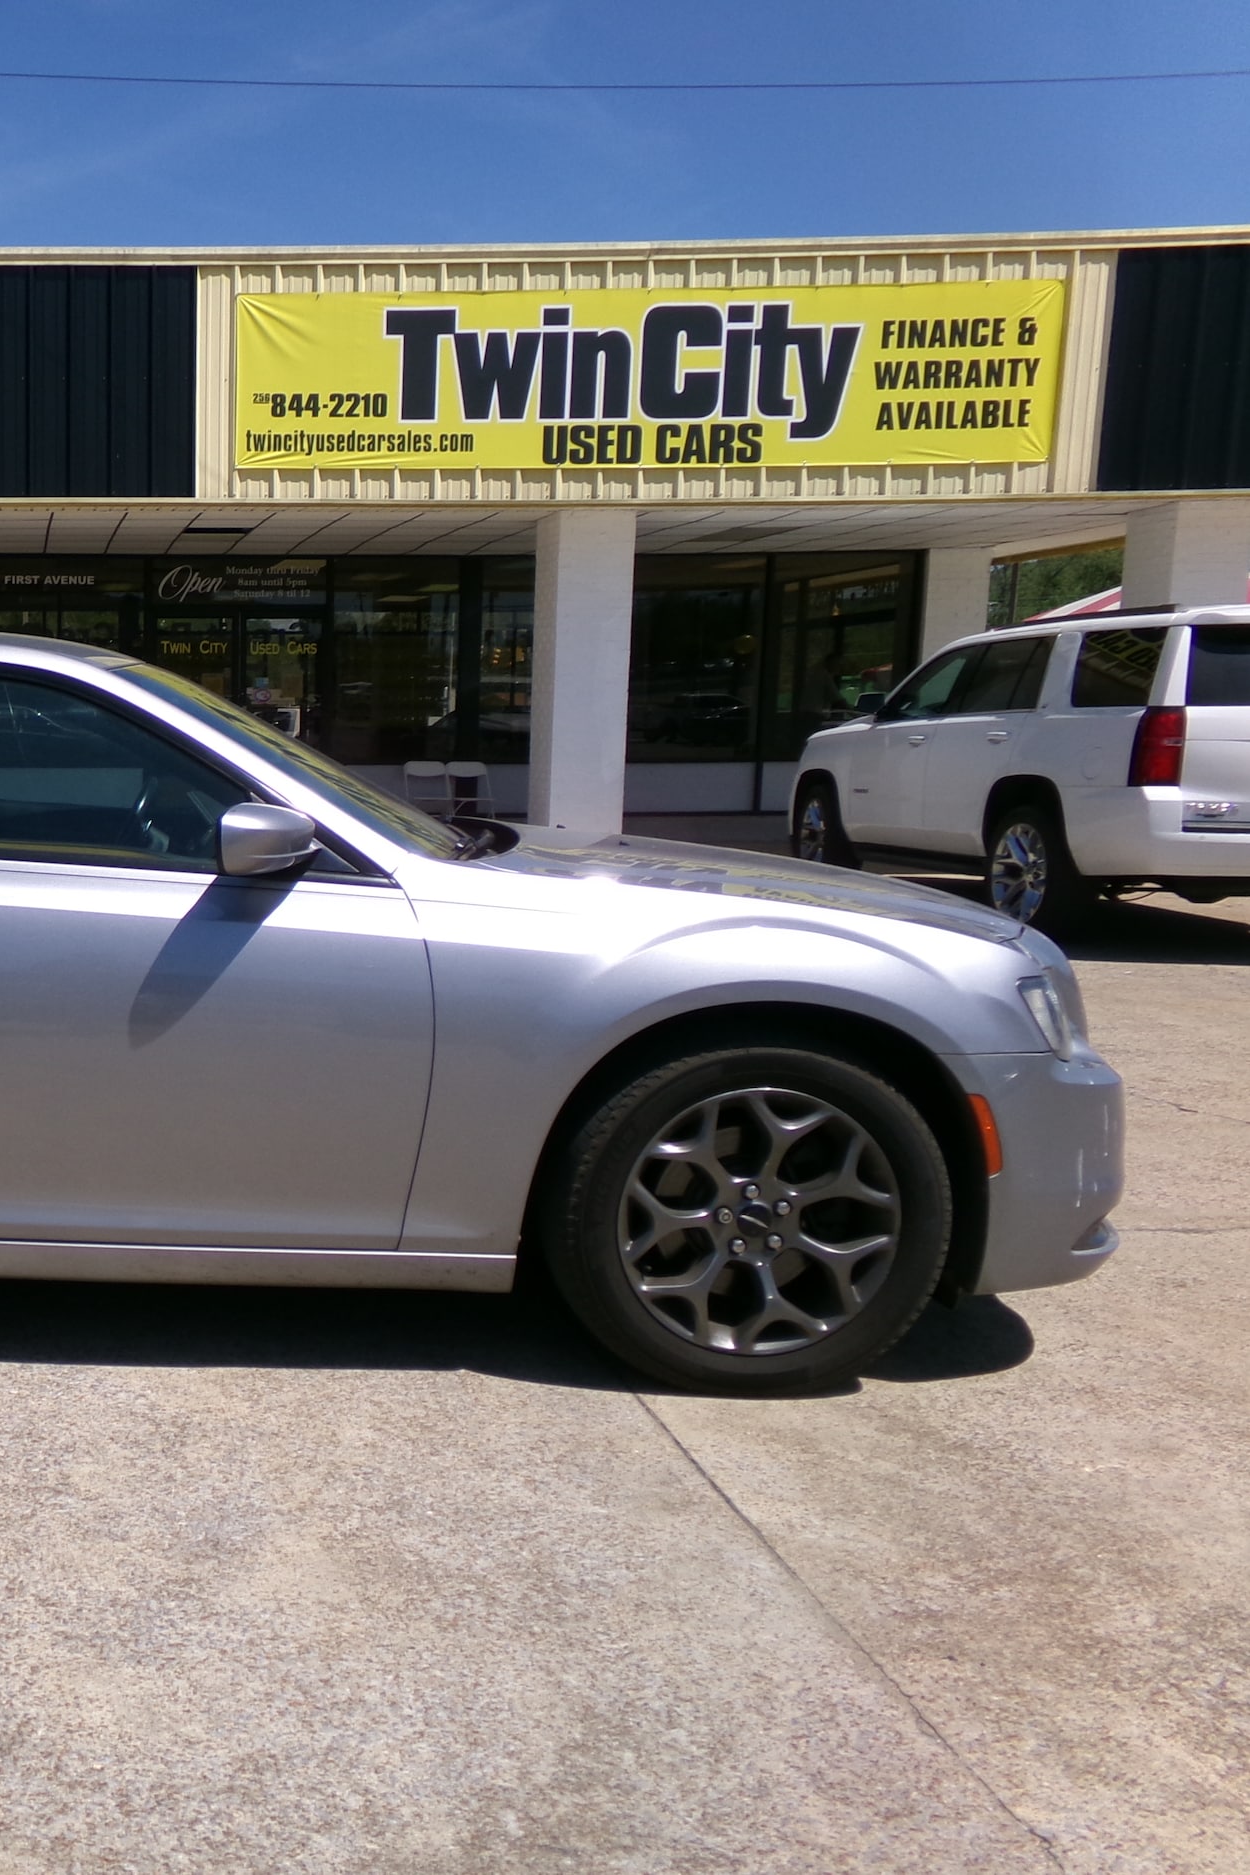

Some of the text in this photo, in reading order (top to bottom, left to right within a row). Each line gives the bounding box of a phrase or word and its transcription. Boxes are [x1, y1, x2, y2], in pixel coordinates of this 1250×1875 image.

[881, 317, 1038, 349] FINANCE &
[874, 358, 1041, 390] WARRANTY
[875, 399, 1031, 430] AVAILABLE
[246, 430, 474, 456] twincityusedcarsales.com
[542, 423, 763, 464] USED CARS
[4, 575, 40, 585] FIRST
[44, 575, 95, 585] AVENUE
[226, 566, 263, 576] Monday
[290, 565, 320, 576] Friday
[158, 564, 226, 602] Open
[238, 577, 307, 588] 8am until 5pm
[234, 589, 274, 599] Saturday
[300, 589, 311, 598] 12
[161, 641, 228, 654] TWIN CITY
[250, 641, 318, 655] USED CARS
